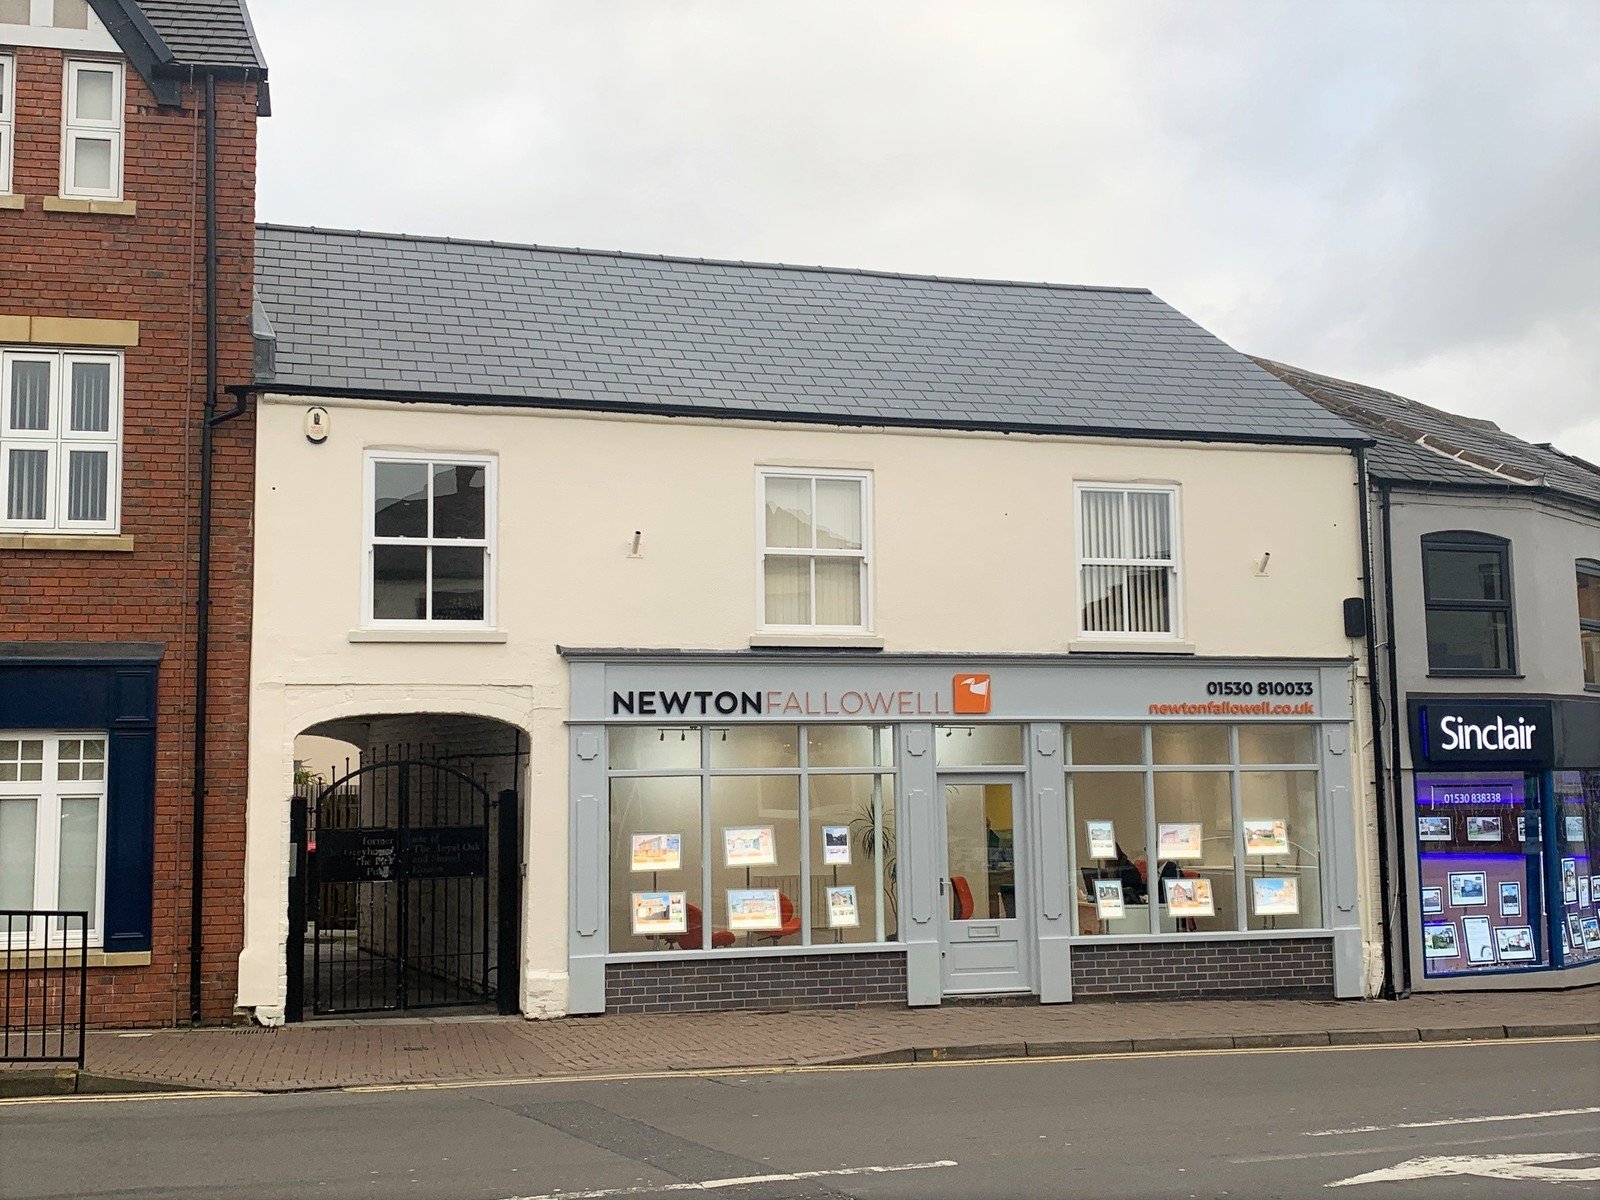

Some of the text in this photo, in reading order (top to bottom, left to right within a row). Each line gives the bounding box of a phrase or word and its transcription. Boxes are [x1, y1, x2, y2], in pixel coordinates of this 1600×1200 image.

[1207, 681, 1314, 696] 01530 810033
[1149, 701, 1315, 715] newtonfallowell.co.uk
[1440, 715, 1536, 750] Sinclair
[1443, 792, 1501, 804] 01530 838338
[362, 836, 394, 846] former
[343, 845, 395, 856] Greyhod
[366, 866, 394, 878] Puc
